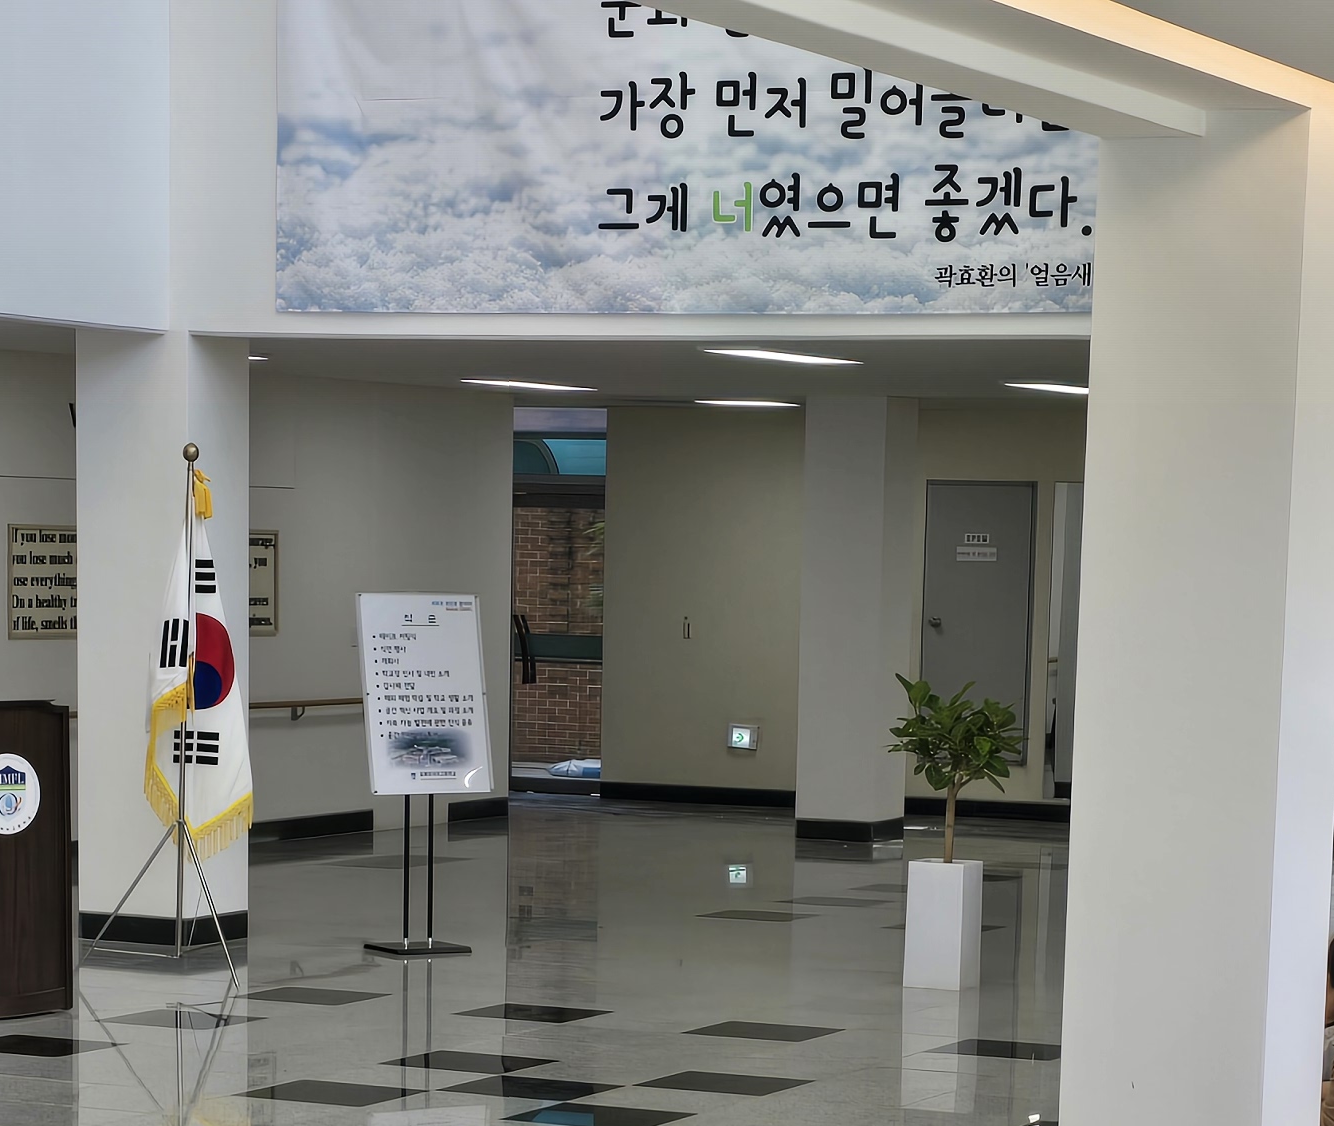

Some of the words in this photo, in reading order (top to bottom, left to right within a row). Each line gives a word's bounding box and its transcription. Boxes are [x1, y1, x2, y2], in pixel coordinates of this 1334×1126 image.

[600, 72, 695, 139] 가장
[716, 72, 806, 138] 먼저
[598, 182, 687, 232] 그게
[712, 172, 900, 239] 너였으면
[924, 164, 1093, 242] 좋겠다.
[934, 264, 1017, 288] 곽효환의
